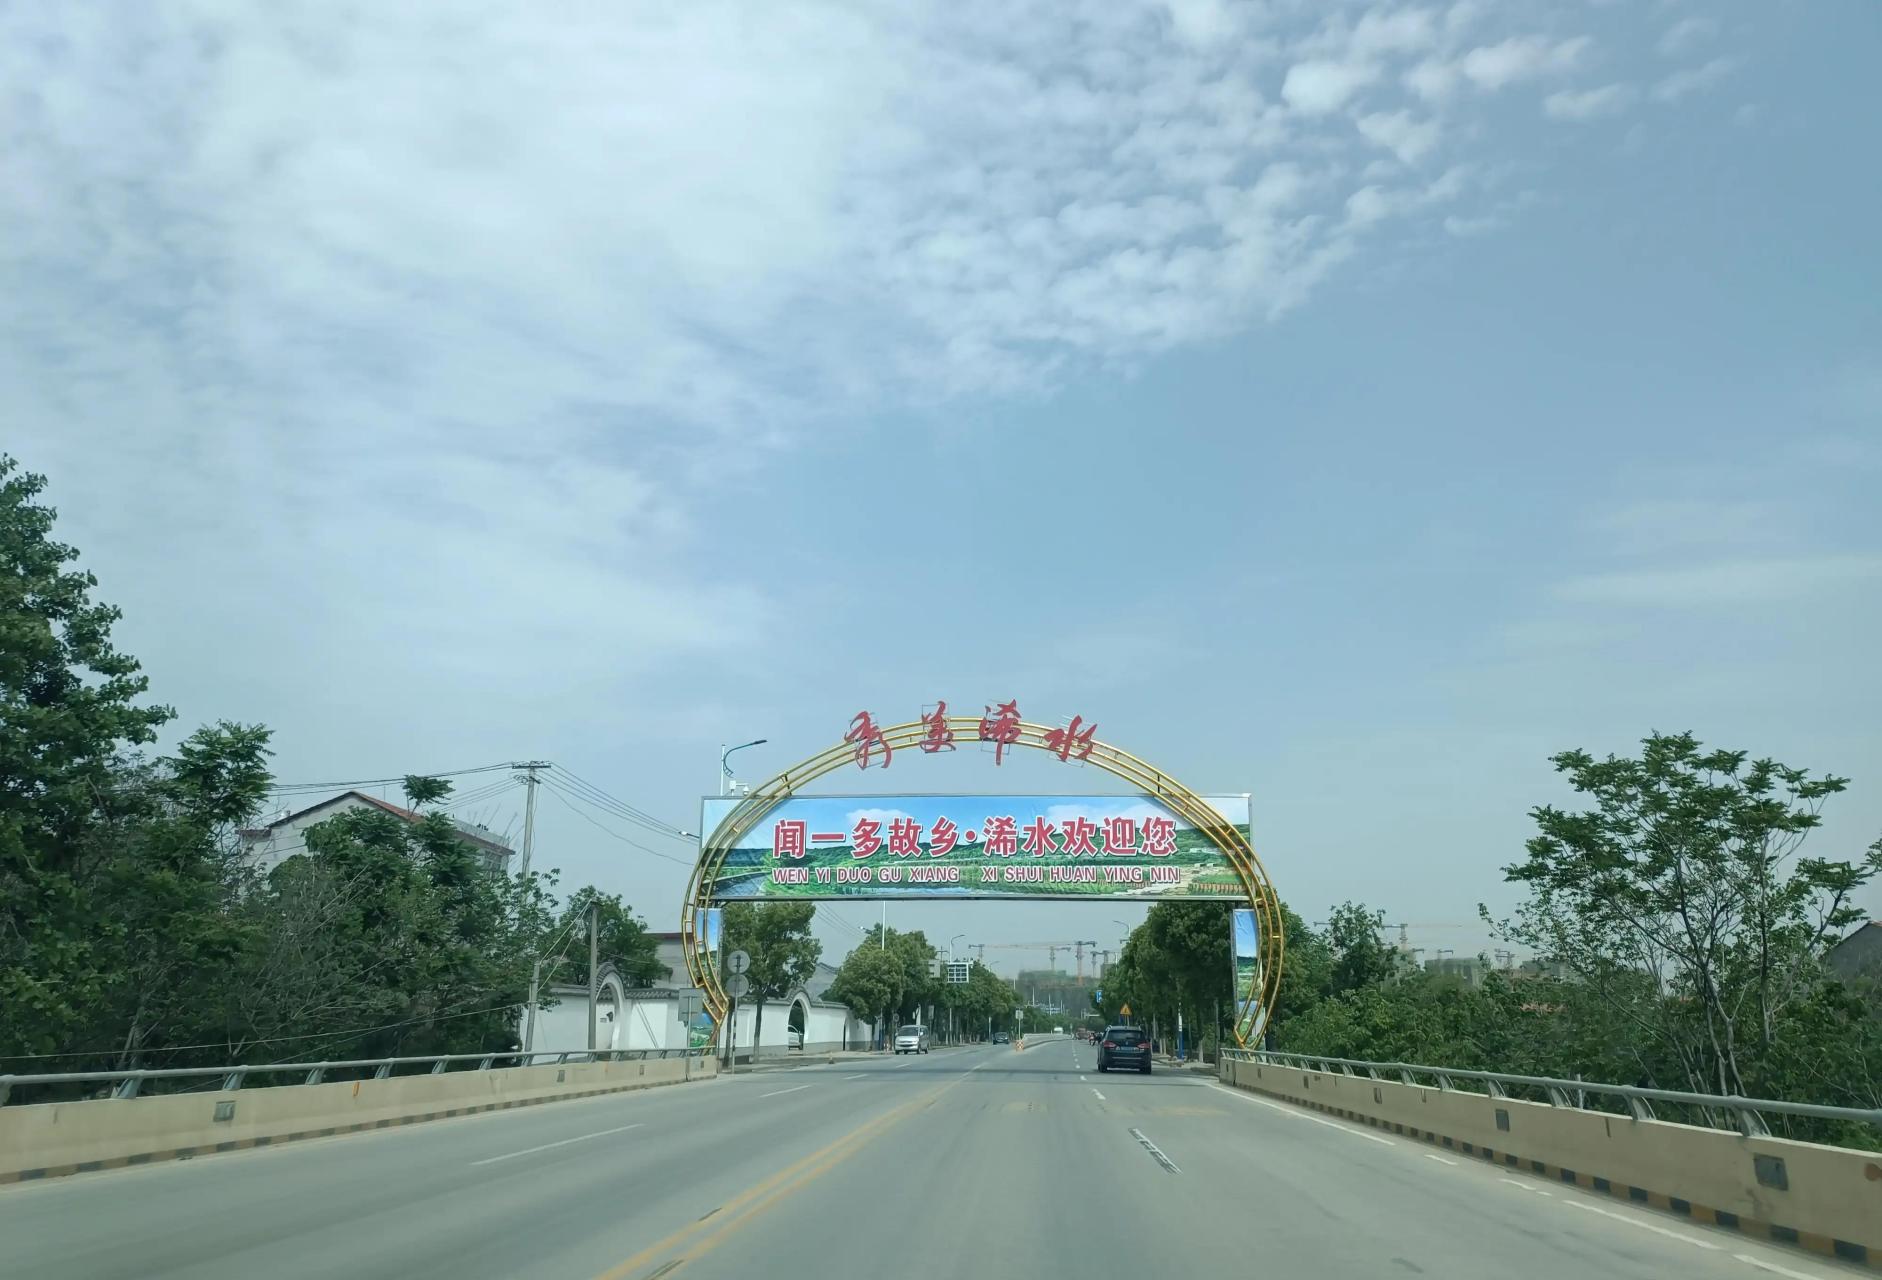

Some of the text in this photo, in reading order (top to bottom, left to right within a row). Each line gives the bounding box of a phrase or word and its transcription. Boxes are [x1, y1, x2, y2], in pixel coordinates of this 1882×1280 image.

[773, 866, 1180, 883] WEN YI DUO GU XIANG XI SHUI HUAN YING NIN
